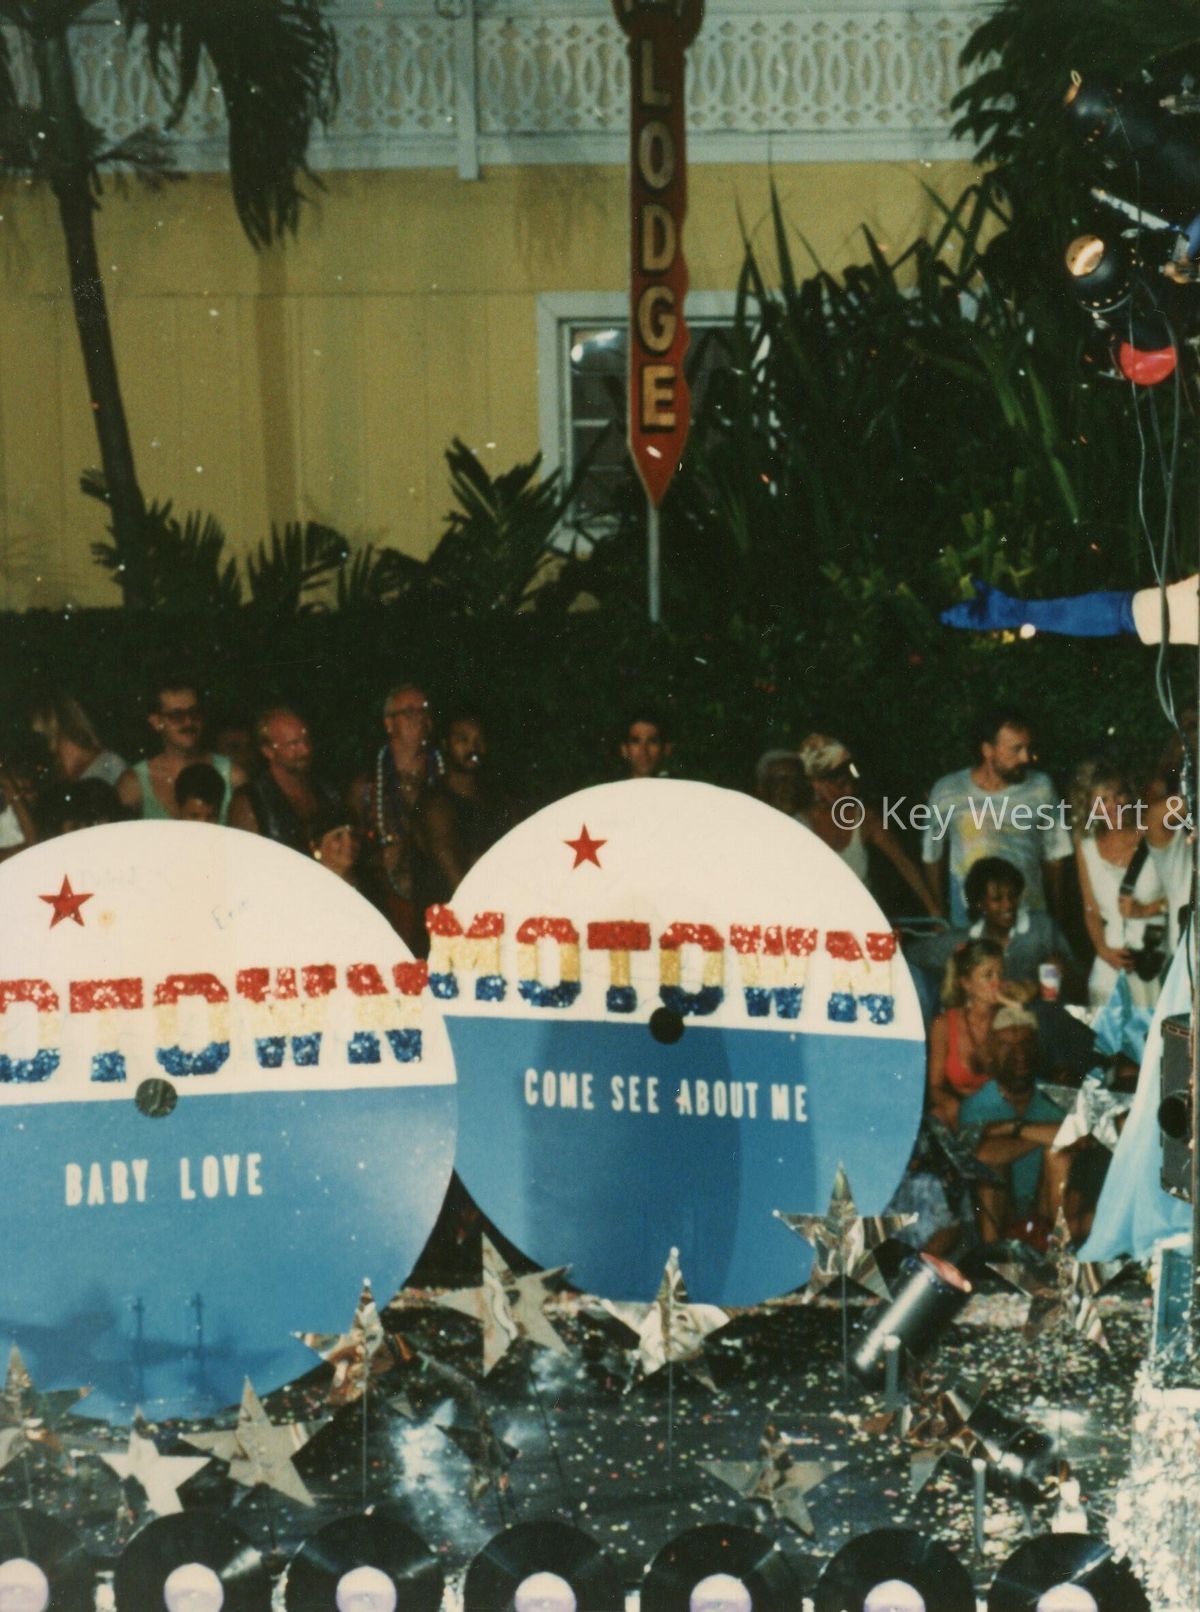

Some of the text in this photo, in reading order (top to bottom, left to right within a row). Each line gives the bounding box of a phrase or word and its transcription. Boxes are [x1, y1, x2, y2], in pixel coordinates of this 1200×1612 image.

[639, 40, 676, 428] LODGE
[0, 961, 428, 1083] OTOWN
[425, 904, 898, 1025] MOTOWN
[523, 1068, 808, 1122] COME SEE ABOUT ME
[65, 1153, 263, 1206] BABY LOVE
